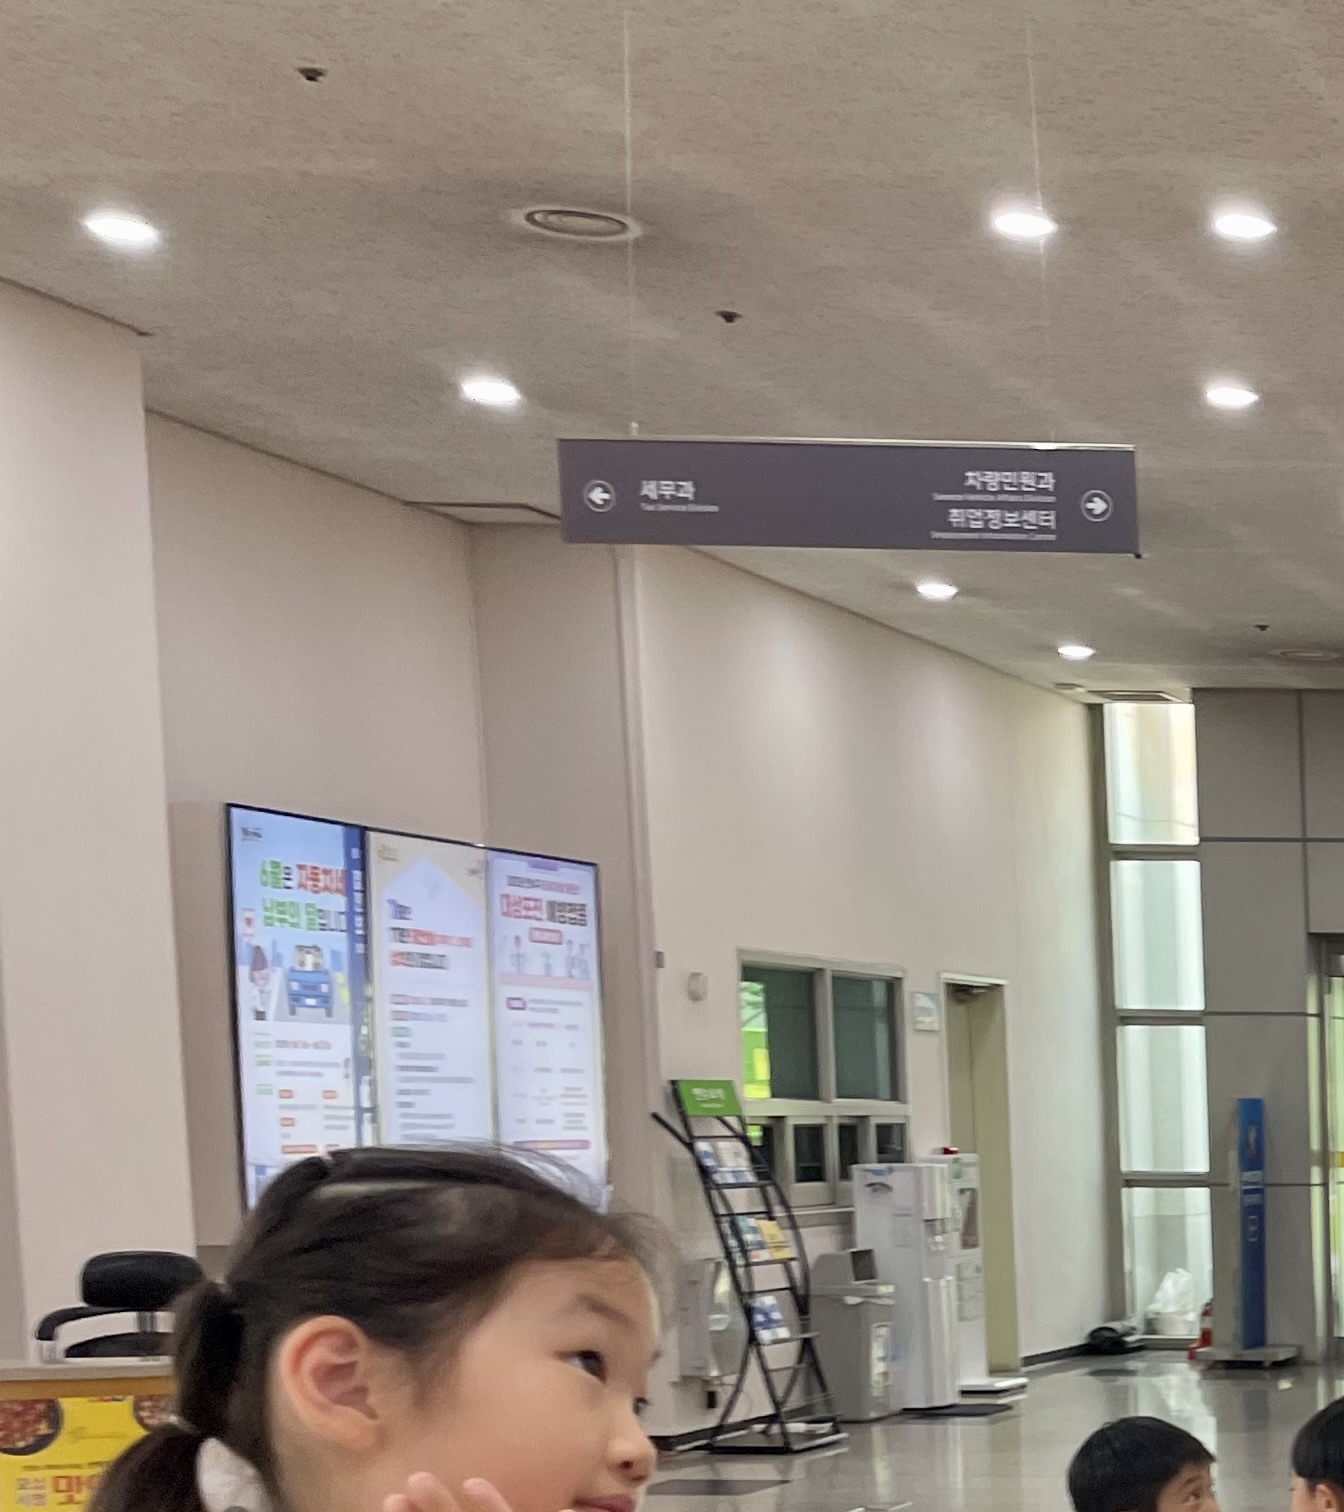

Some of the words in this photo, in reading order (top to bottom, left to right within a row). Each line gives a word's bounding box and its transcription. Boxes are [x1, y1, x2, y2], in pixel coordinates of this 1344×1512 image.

[640, 480, 696, 500] 세무과
[964, 471, 1056, 491] 차량민원과
[948, 509, 1057, 530] 취업정보센터
